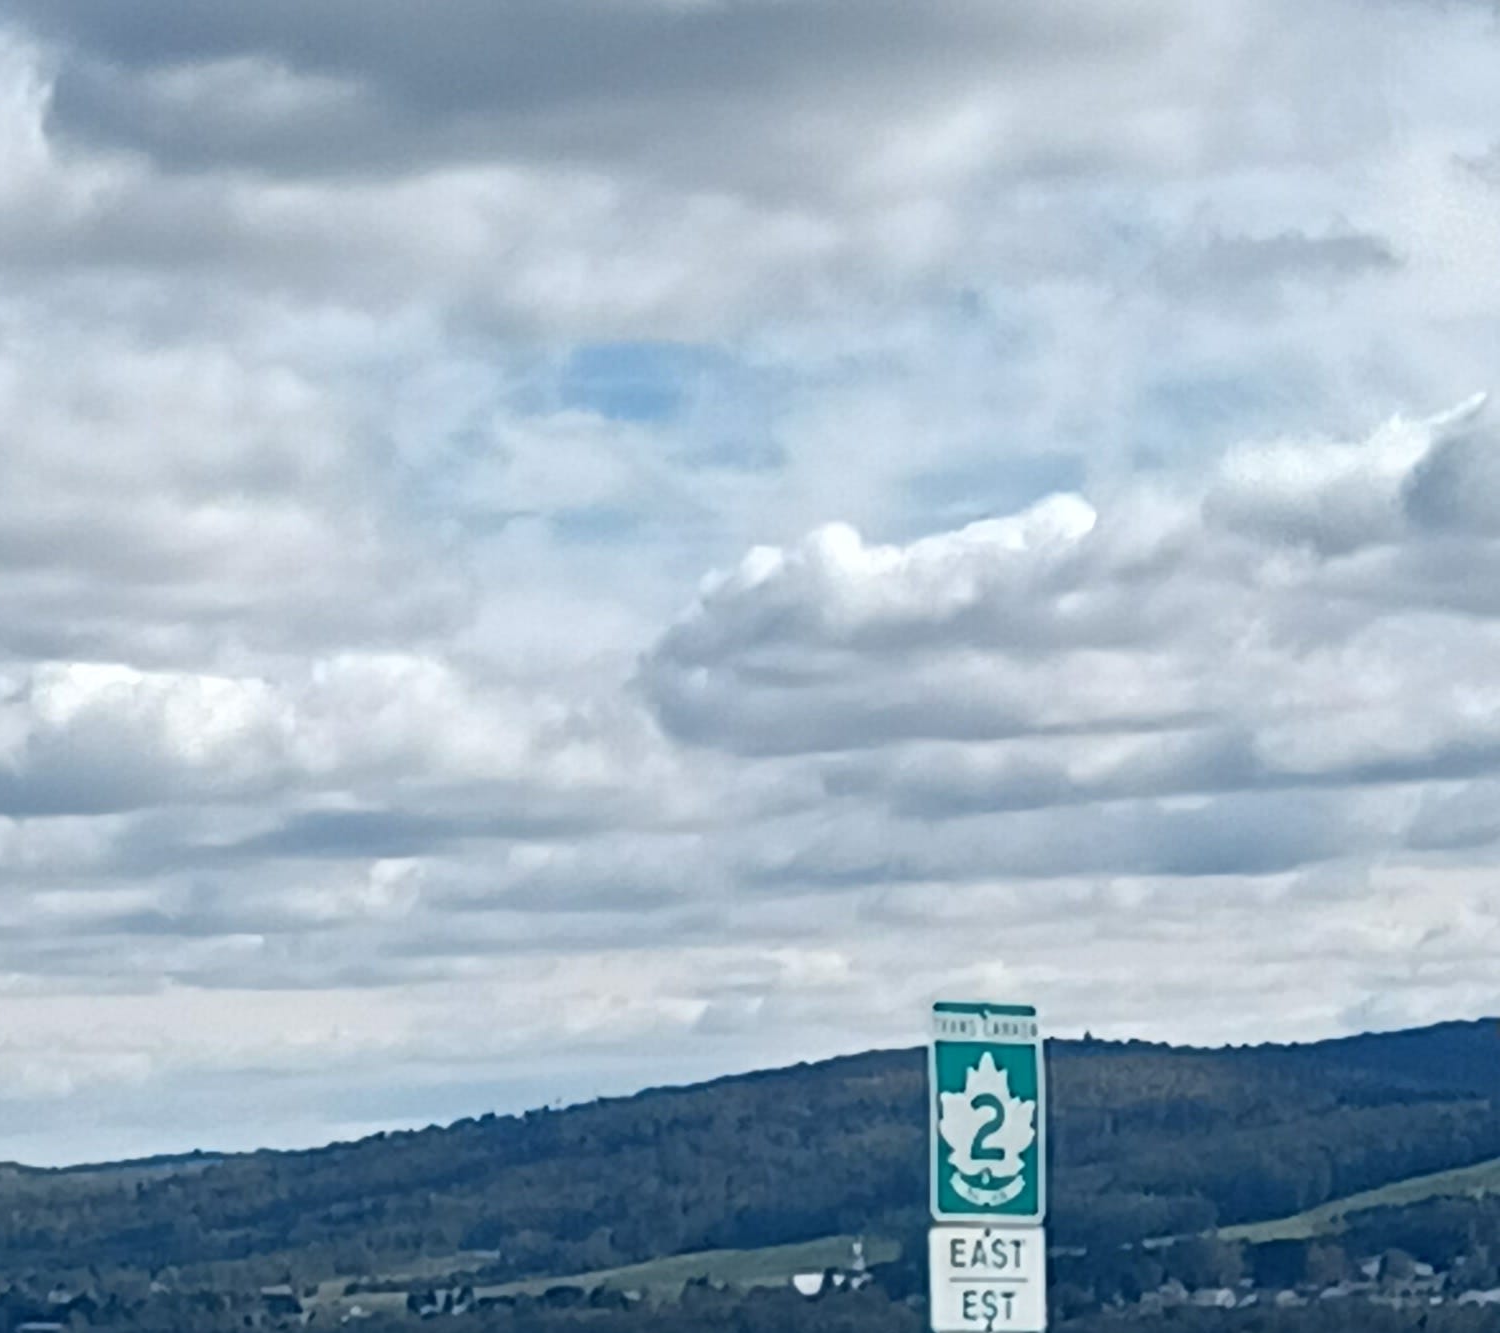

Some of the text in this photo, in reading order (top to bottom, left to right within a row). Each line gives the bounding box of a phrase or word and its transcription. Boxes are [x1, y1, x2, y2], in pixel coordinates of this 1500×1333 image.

[970, 1092, 1006, 1160] 2
[949, 1237, 1026, 1269] EAST
[962, 1289, 1016, 1321] EST
